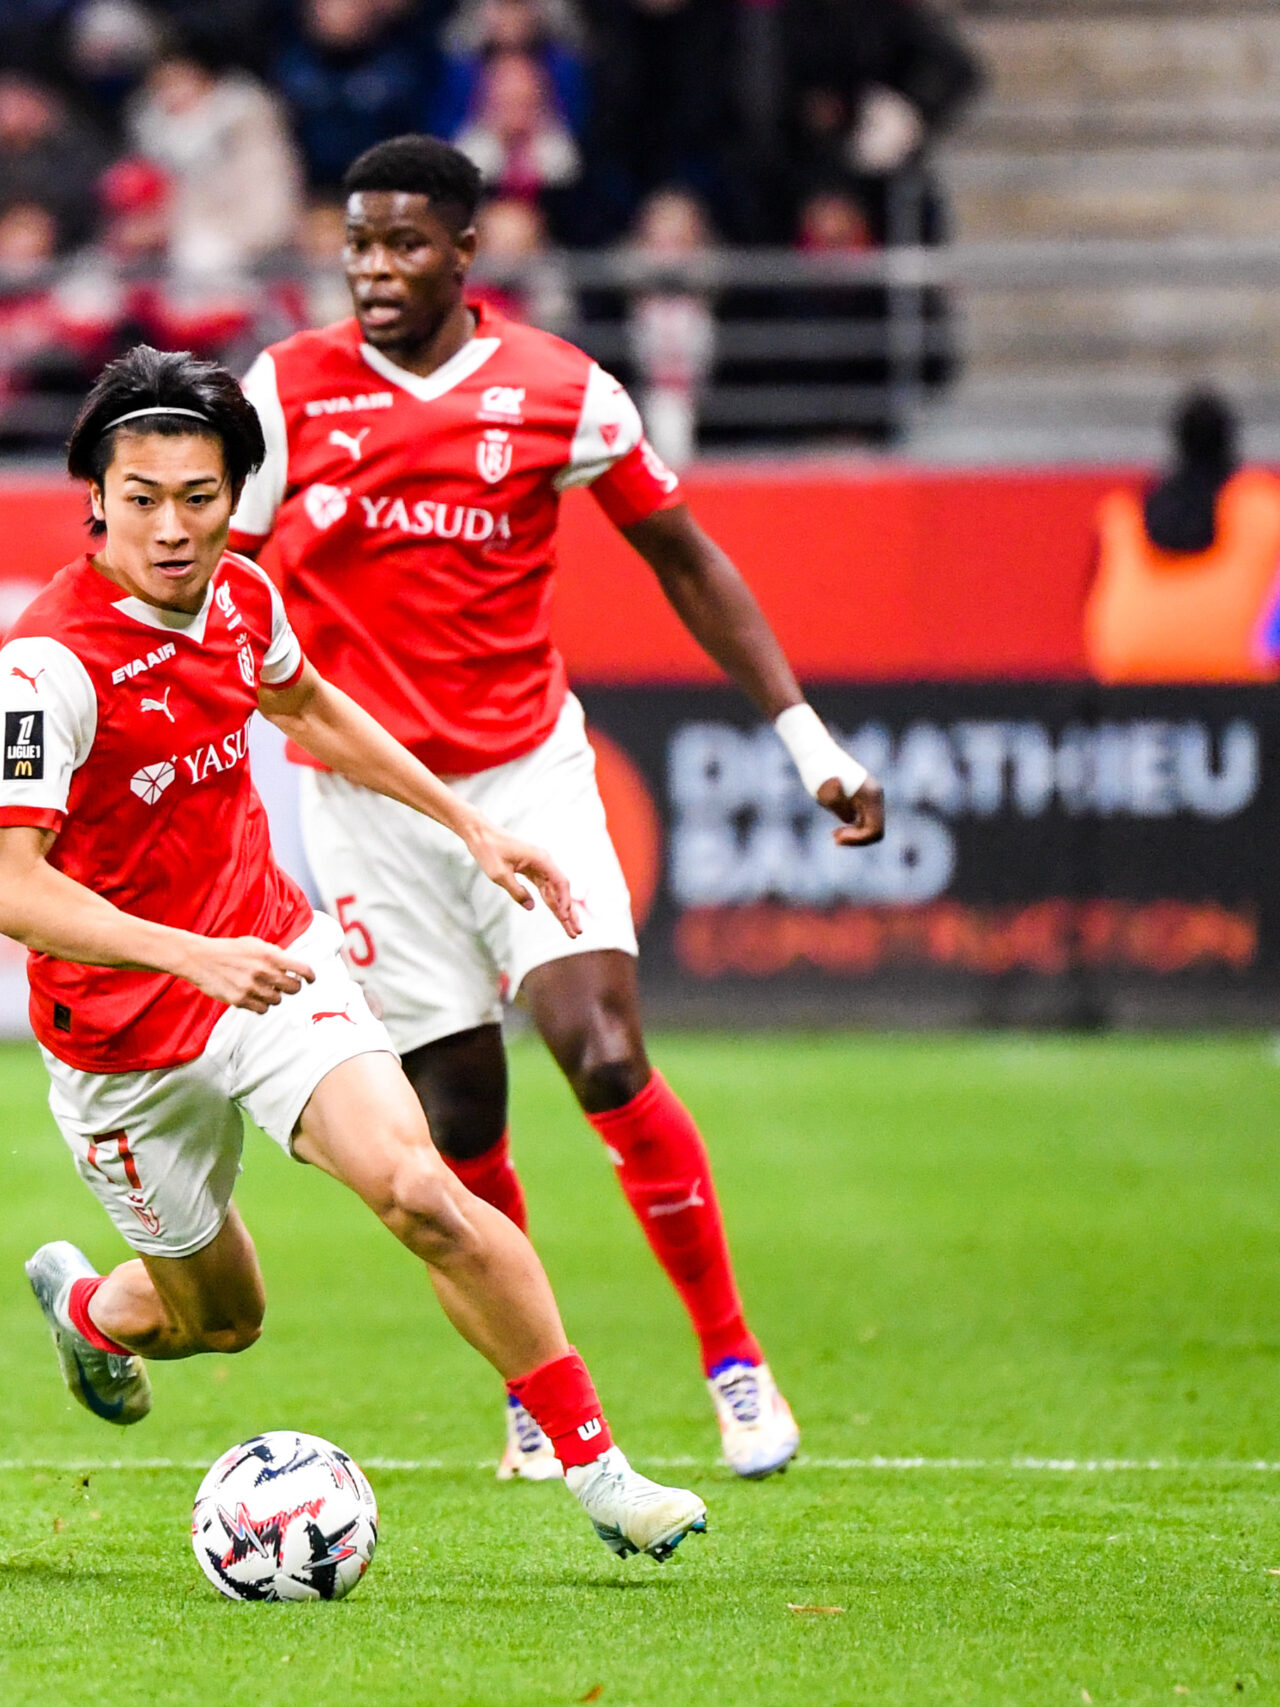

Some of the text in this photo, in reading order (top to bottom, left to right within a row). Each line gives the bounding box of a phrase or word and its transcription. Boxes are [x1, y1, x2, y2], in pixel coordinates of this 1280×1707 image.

[111, 642, 177, 685] EVA AIR
[182, 715, 252, 785] YASU
[335, 893, 378, 968] 5
